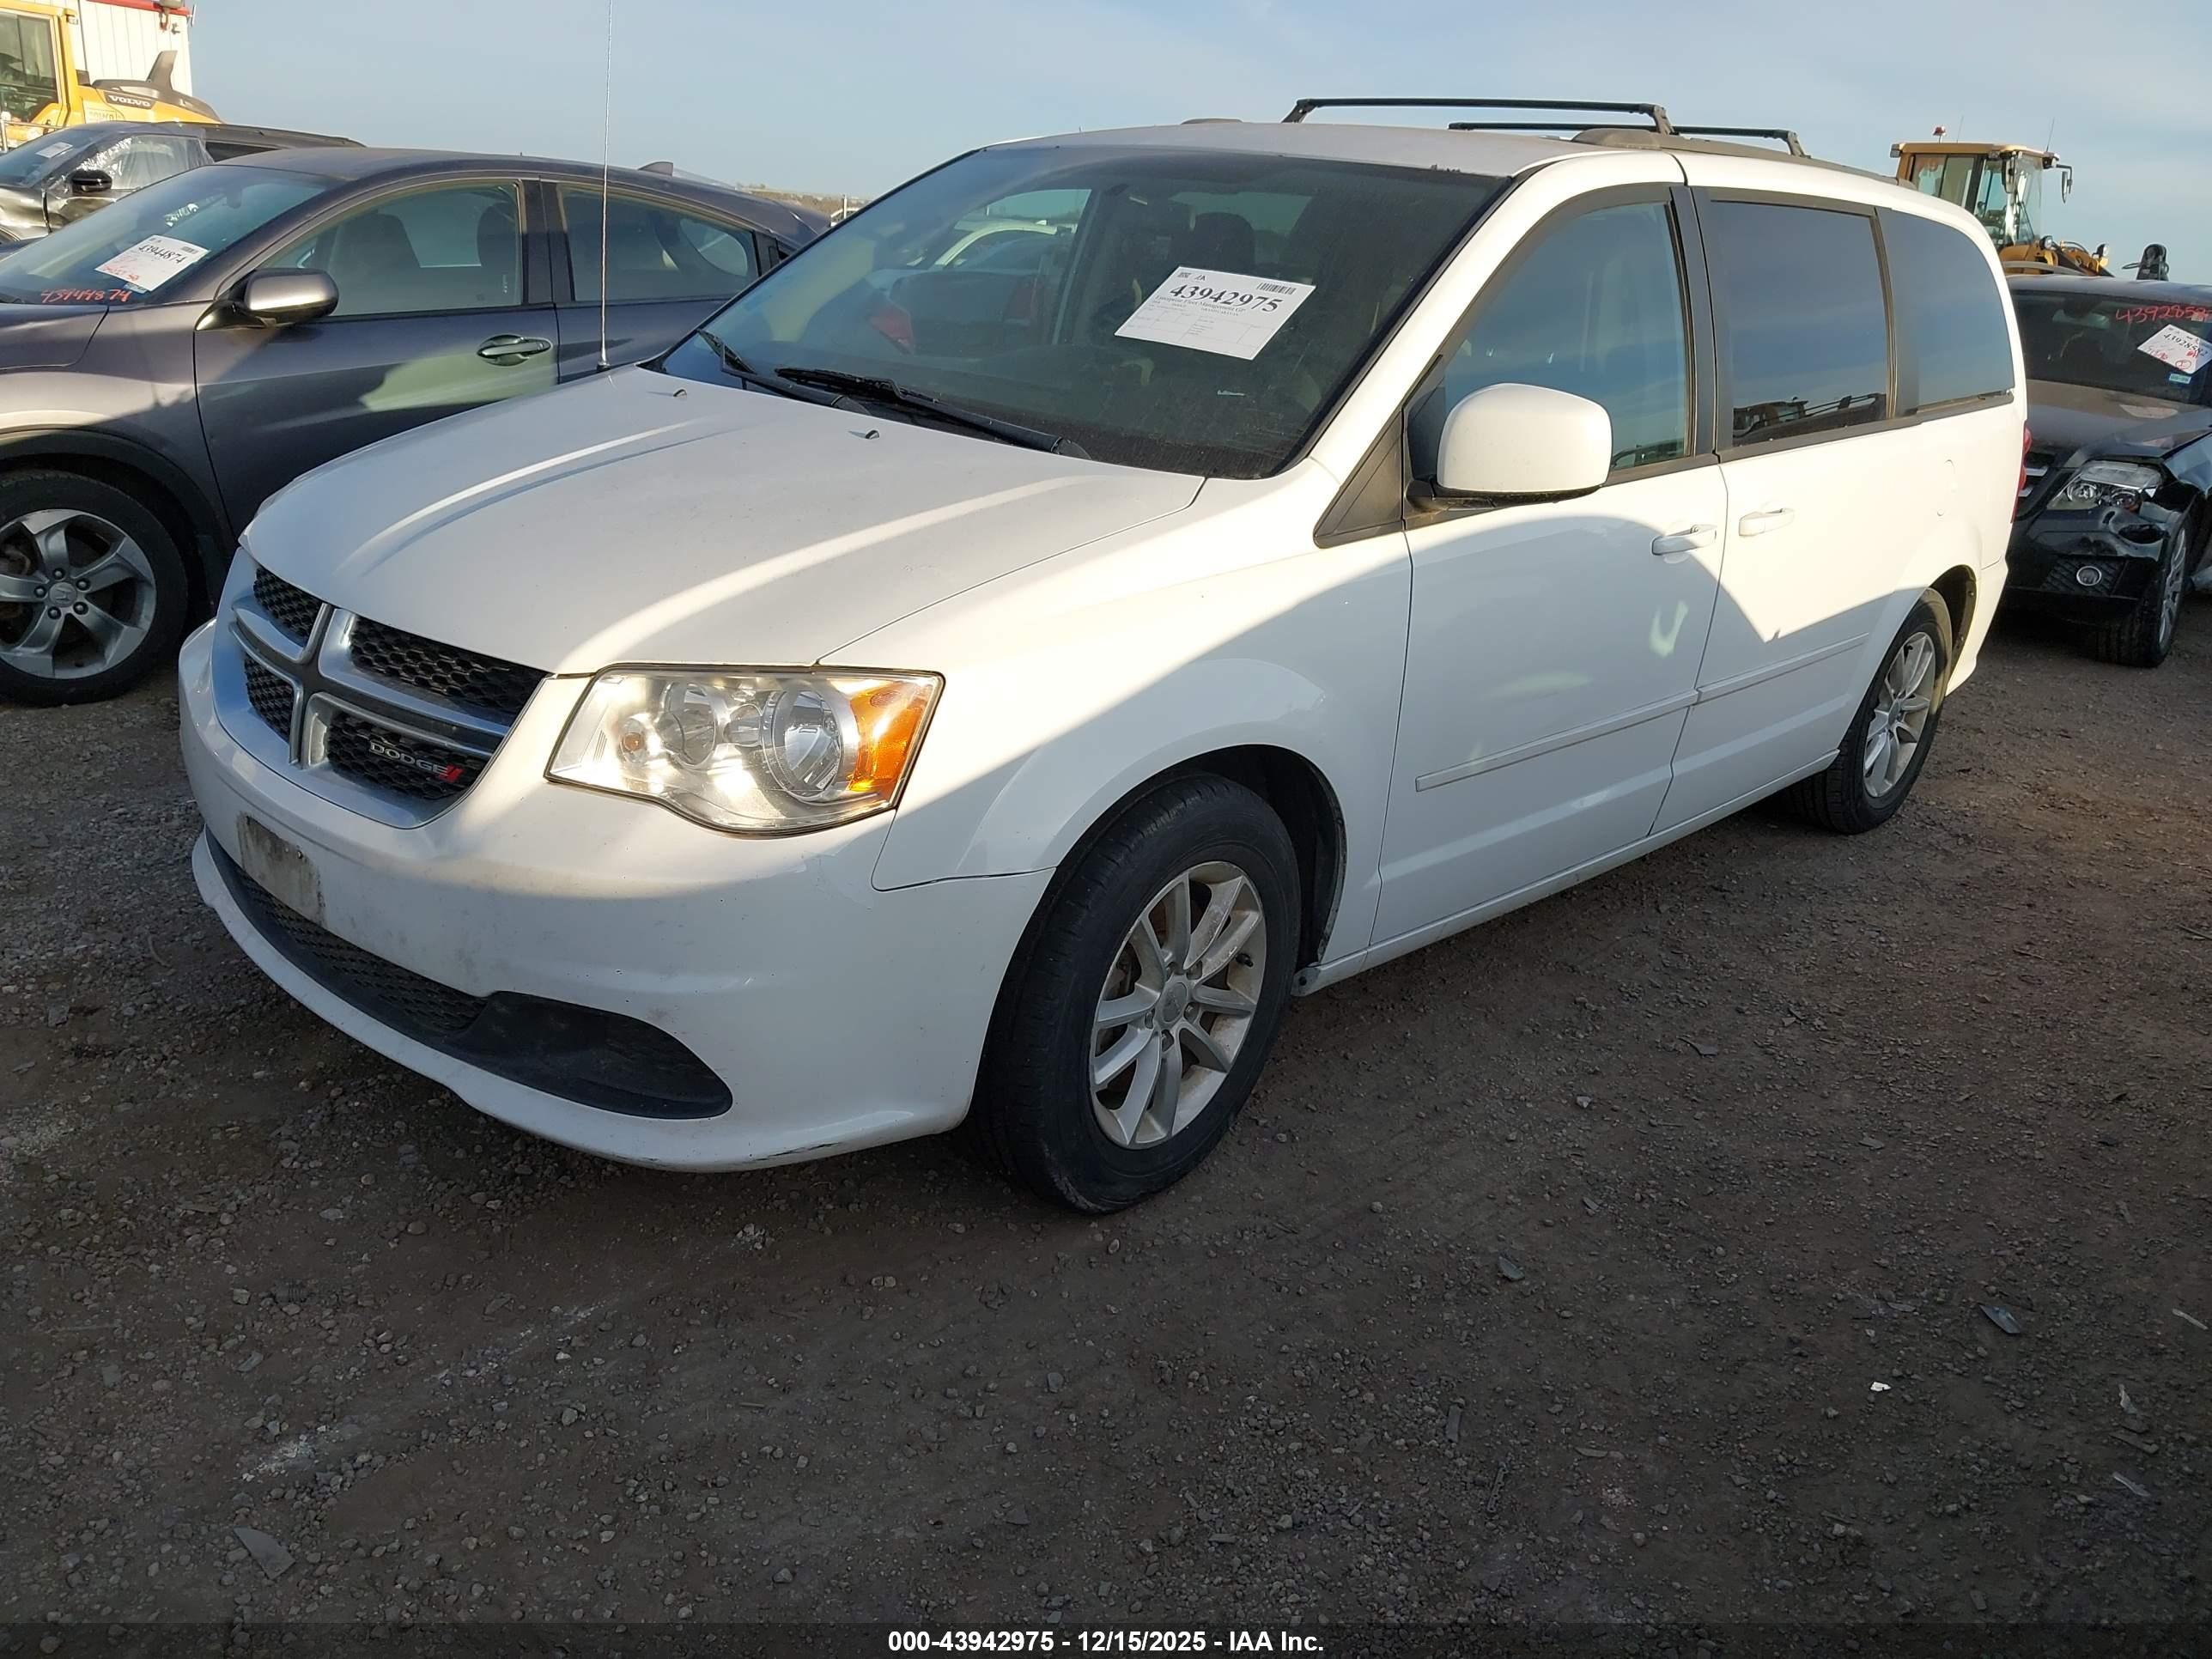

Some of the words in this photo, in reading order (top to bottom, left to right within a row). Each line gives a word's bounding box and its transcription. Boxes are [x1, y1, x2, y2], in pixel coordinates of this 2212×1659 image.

[108, 95, 151, 106] VOLVO
[138, 244, 186, 264] 43944874
[1170, 284, 1283, 313] 43942975
[370, 741, 449, 776] DODGE
